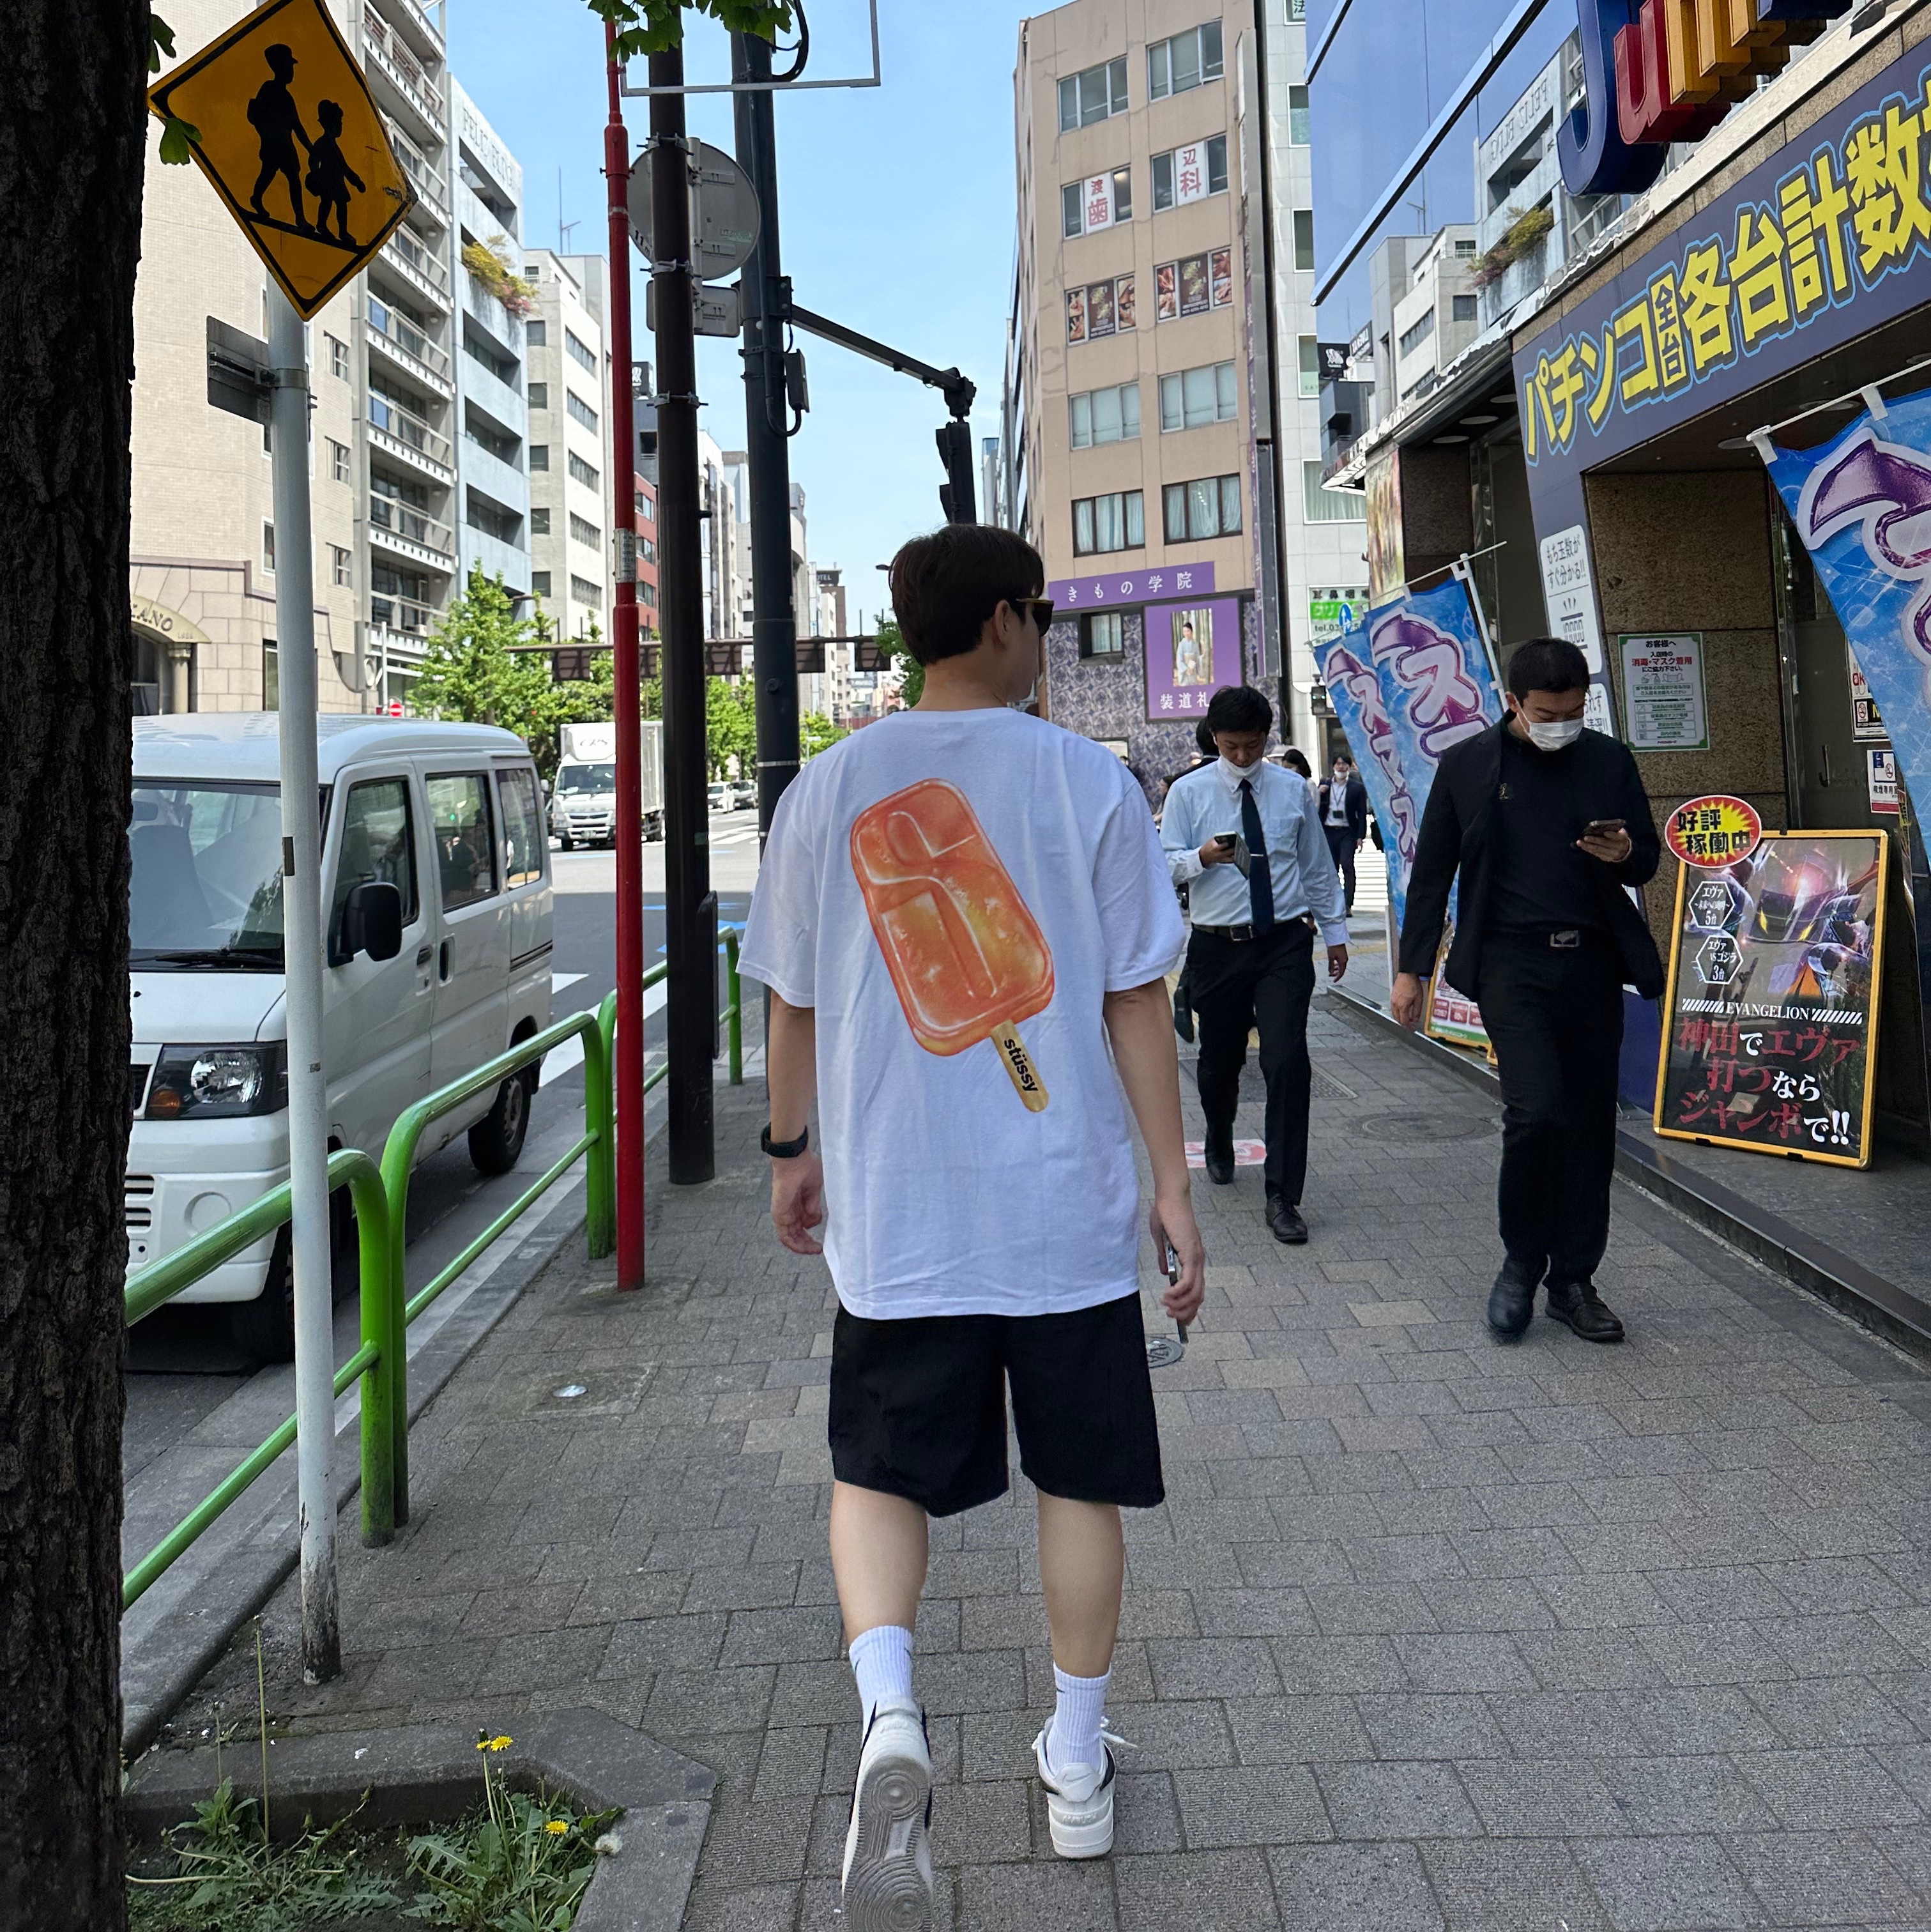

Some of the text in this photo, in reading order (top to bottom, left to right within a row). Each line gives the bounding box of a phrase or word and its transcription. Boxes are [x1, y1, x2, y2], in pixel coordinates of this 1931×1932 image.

[1067, 571, 1193, 602] きもの学院
[1677, 809, 1721, 832] 好評
[1685, 830, 1752, 855] 稼働中
[1702, 885, 1724, 898] エヴァ
[1707, 939, 1727, 951] エヴァ
[1726, 1002, 1810, 1021] EVANGELION
[1679, 1016, 1861, 1066] 神田でエヴァ
[1004, 1038, 1039, 1092] stüssy
[1706, 1055, 1820, 1101] 打つなら
